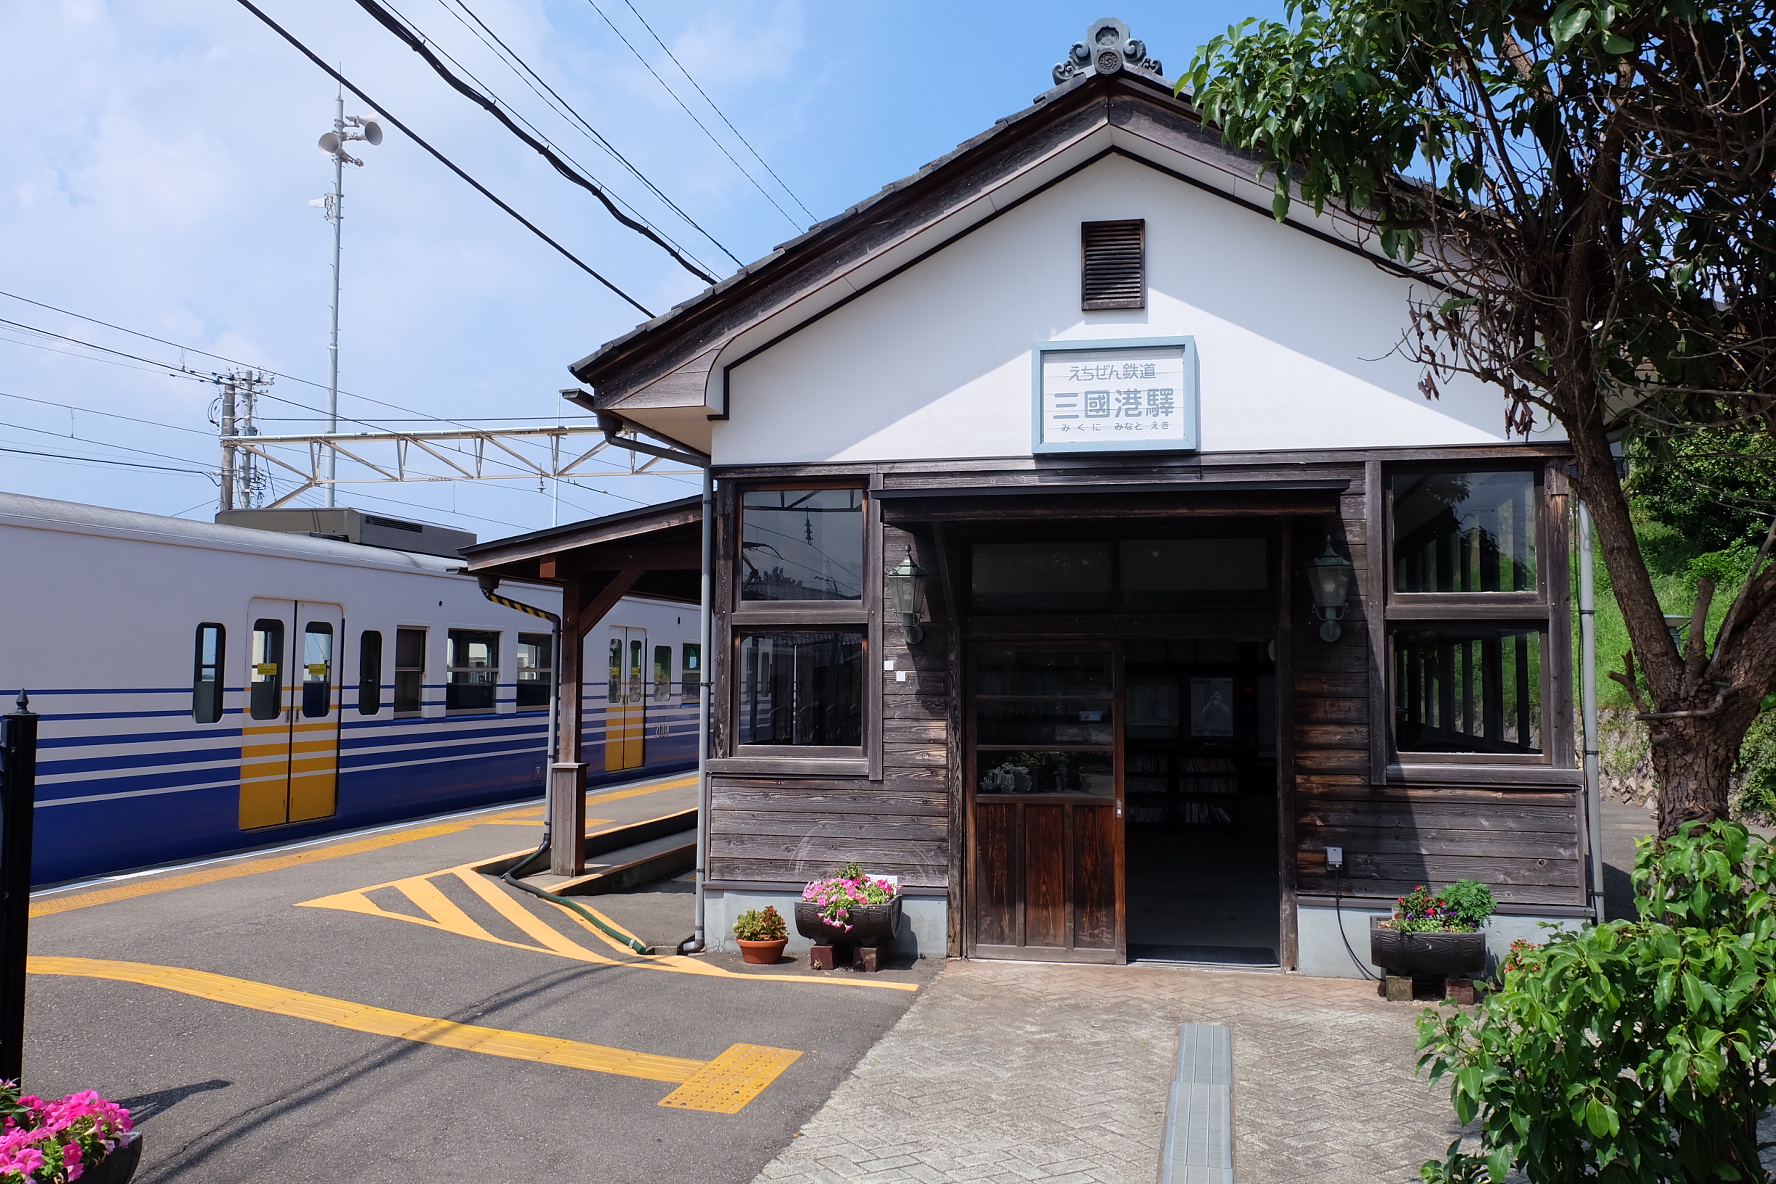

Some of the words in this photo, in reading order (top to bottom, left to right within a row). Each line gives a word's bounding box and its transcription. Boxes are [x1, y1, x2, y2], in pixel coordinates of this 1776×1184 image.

[1069, 363, 1156, 381] えちぜん鉄道
[1053, 387, 1175, 419] 三國港驛
